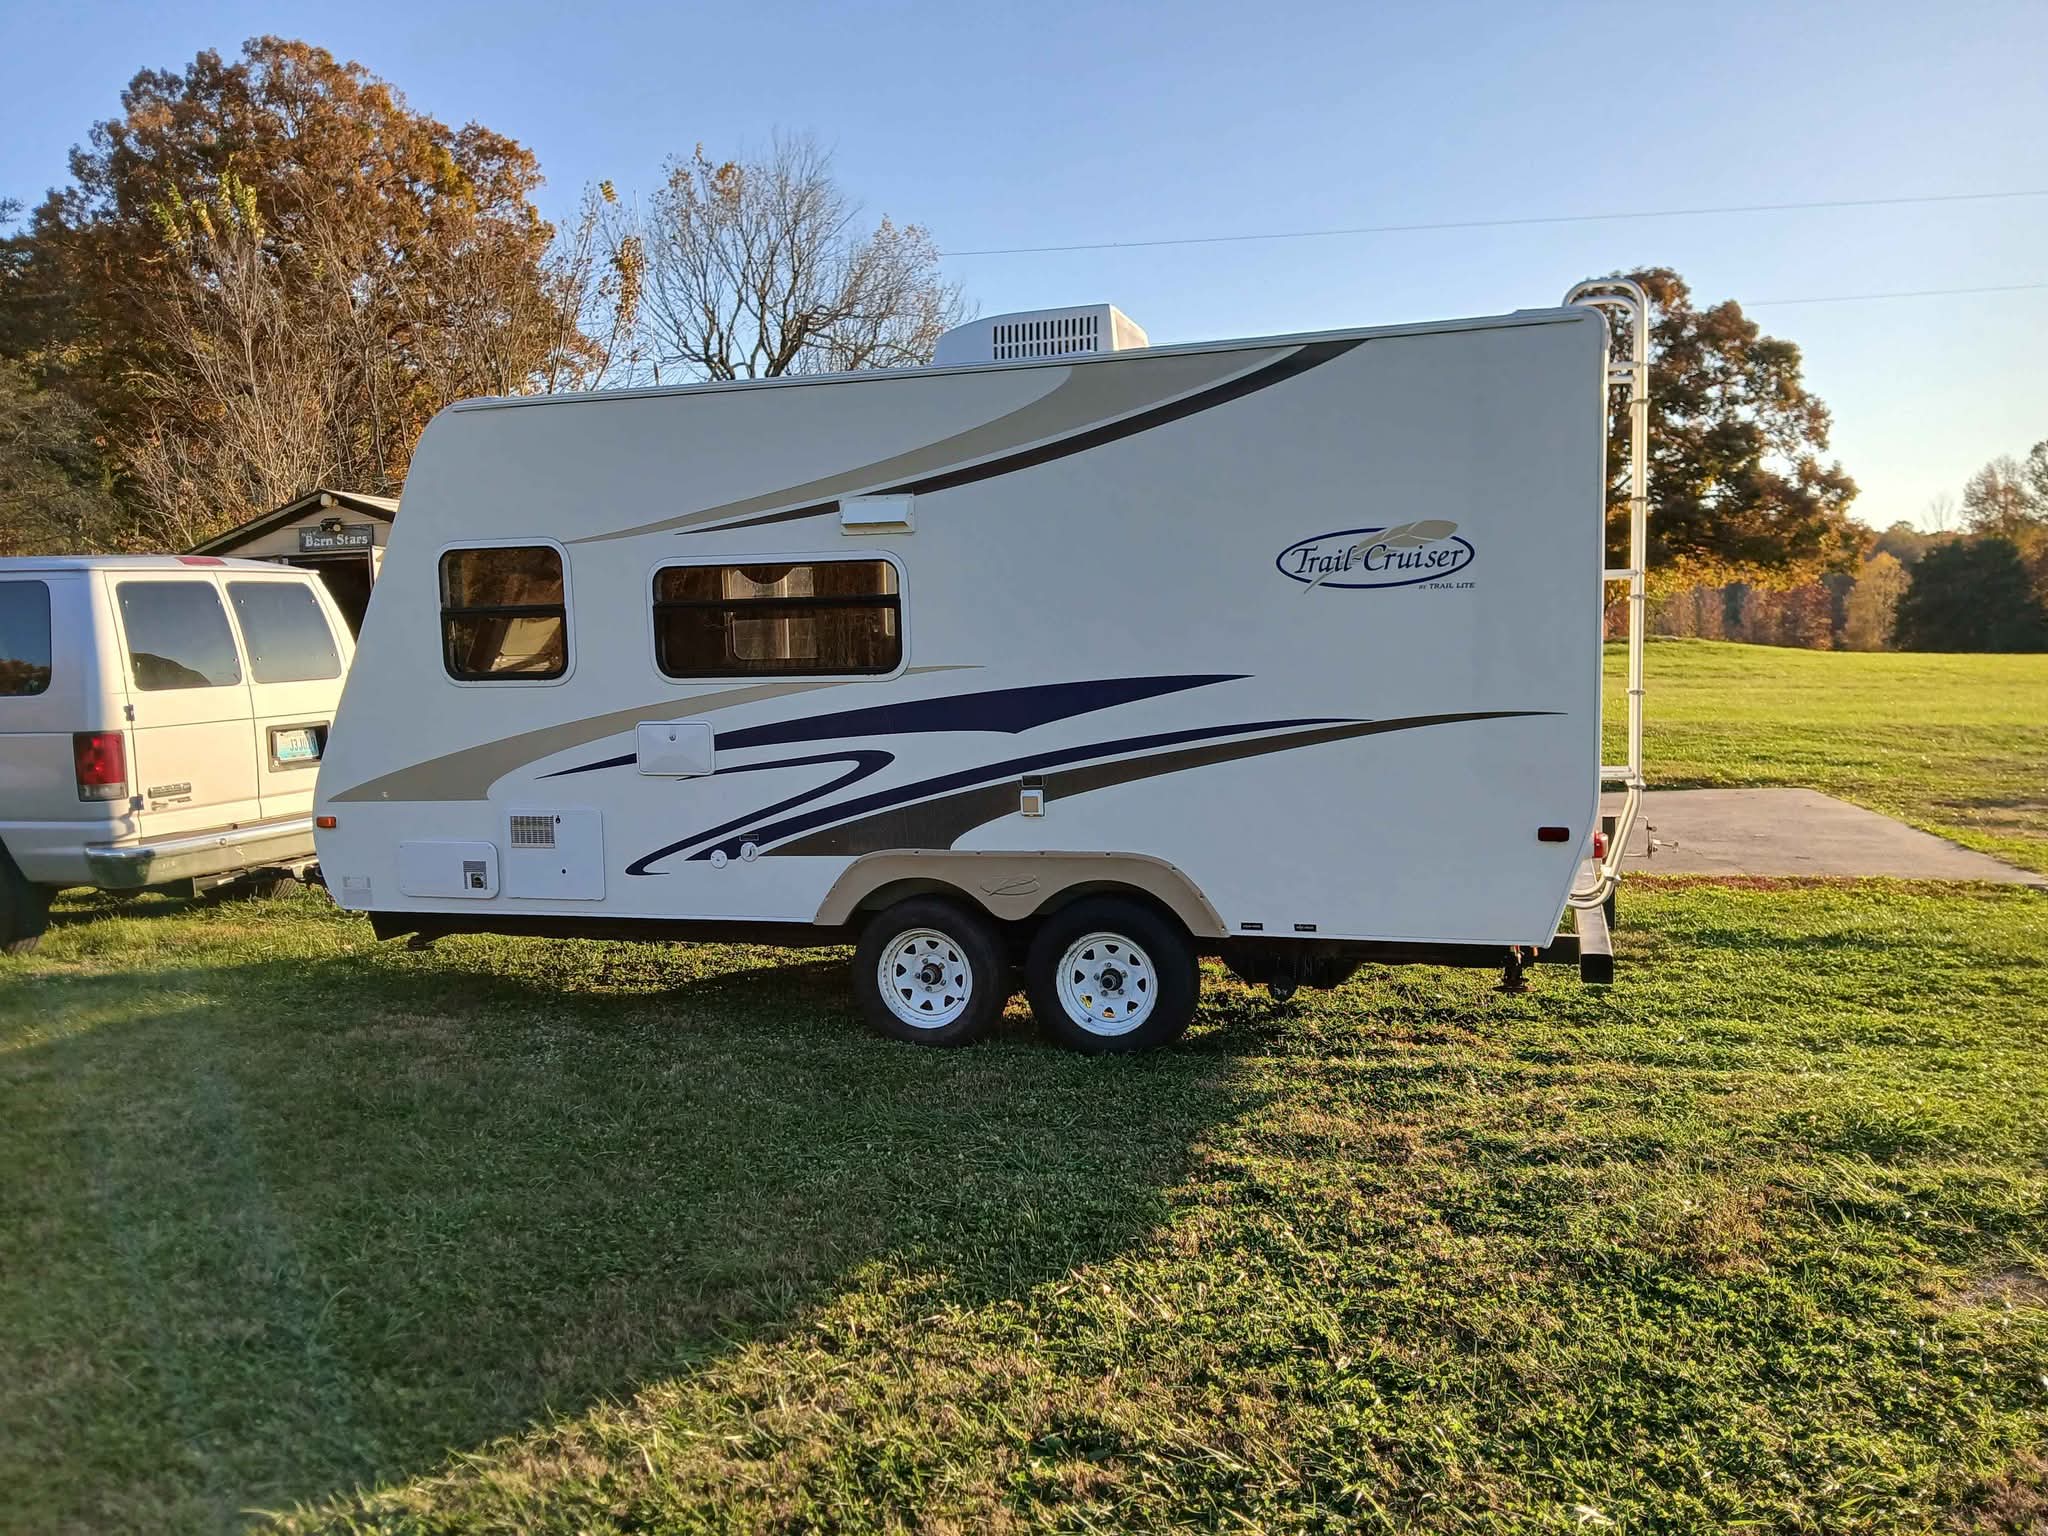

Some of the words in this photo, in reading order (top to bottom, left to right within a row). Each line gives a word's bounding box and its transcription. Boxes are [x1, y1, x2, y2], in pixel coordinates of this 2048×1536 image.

[305, 535, 333, 547] Barn
[336, 533, 369, 546] Stars
[1429, 582, 1454, 590] TRAIL
[1456, 581, 1476, 589] LITE
